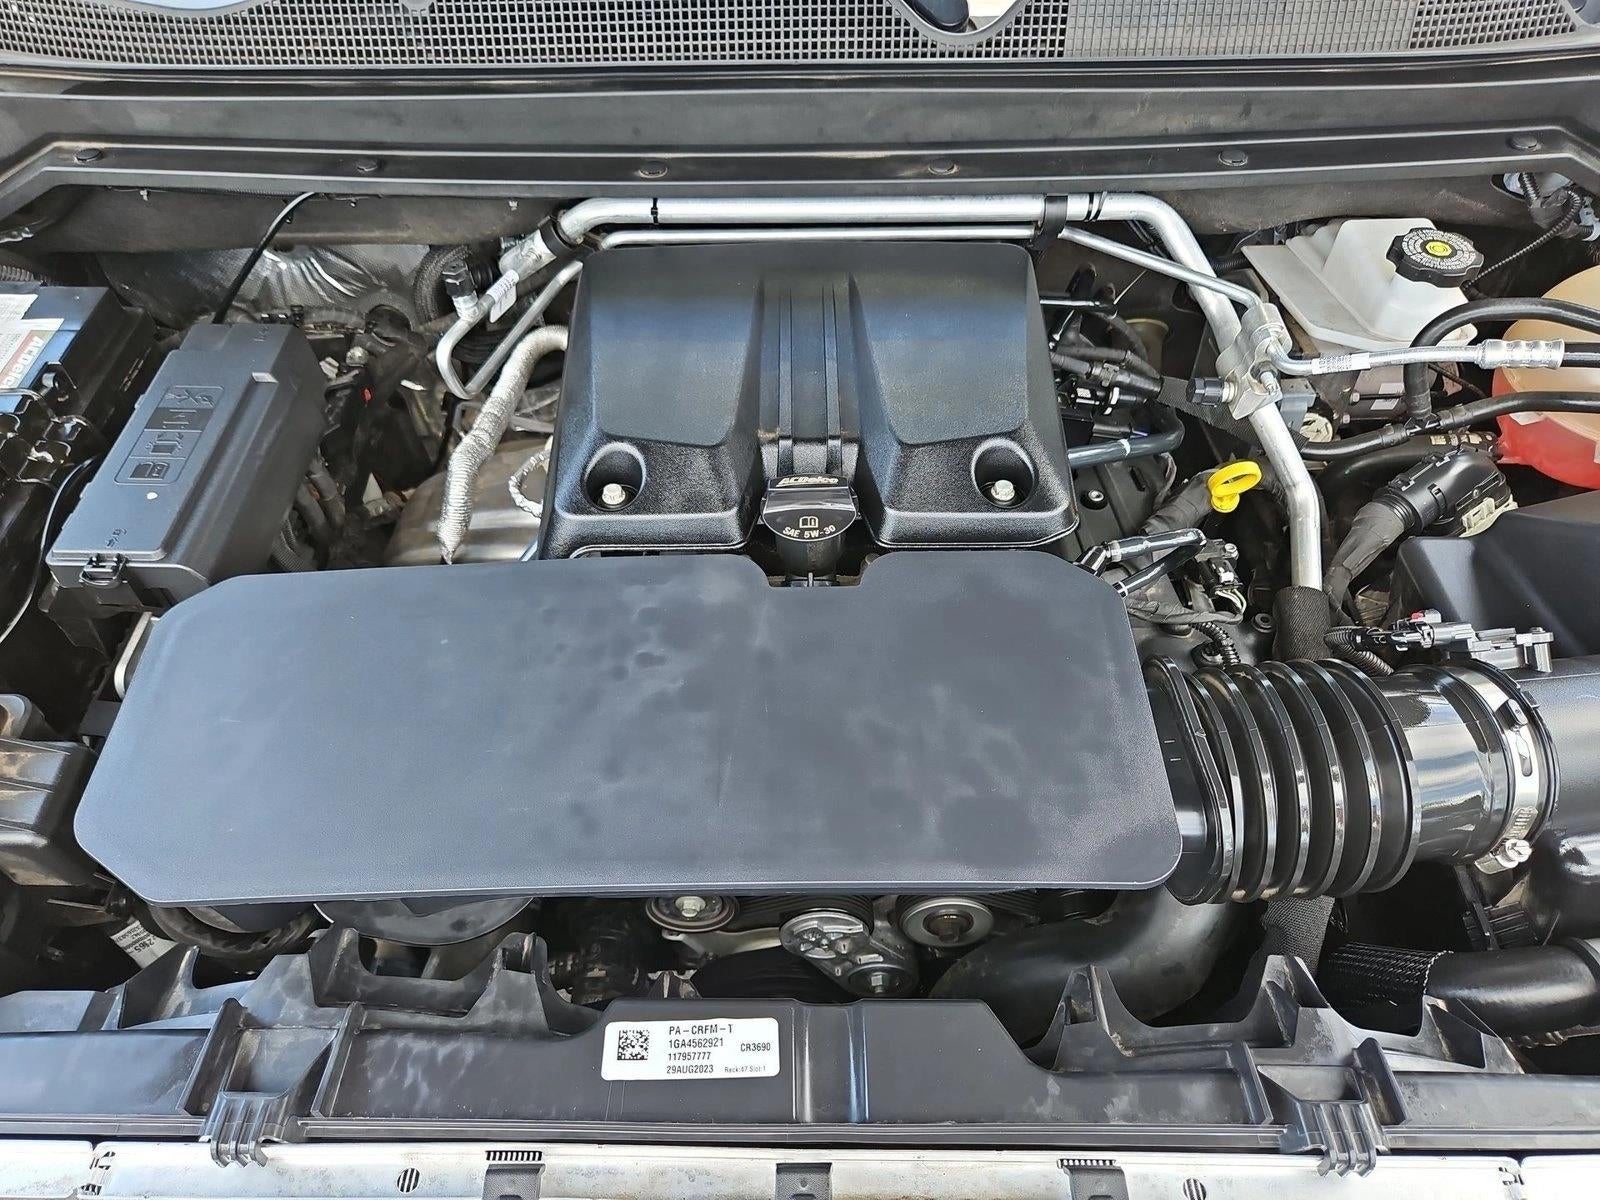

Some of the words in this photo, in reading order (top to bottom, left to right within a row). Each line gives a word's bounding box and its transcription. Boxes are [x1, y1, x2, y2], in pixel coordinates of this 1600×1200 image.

[782, 526, 801, 538] SAE
[803, 524, 836, 538] 5W-30
[669, 1037, 724, 1049] 1GA4562921
[740, 1042, 771, 1052] CR3690
[668, 1051, 712, 1061] 117957777
[666, 1064, 714, 1074] 29AUG2023
